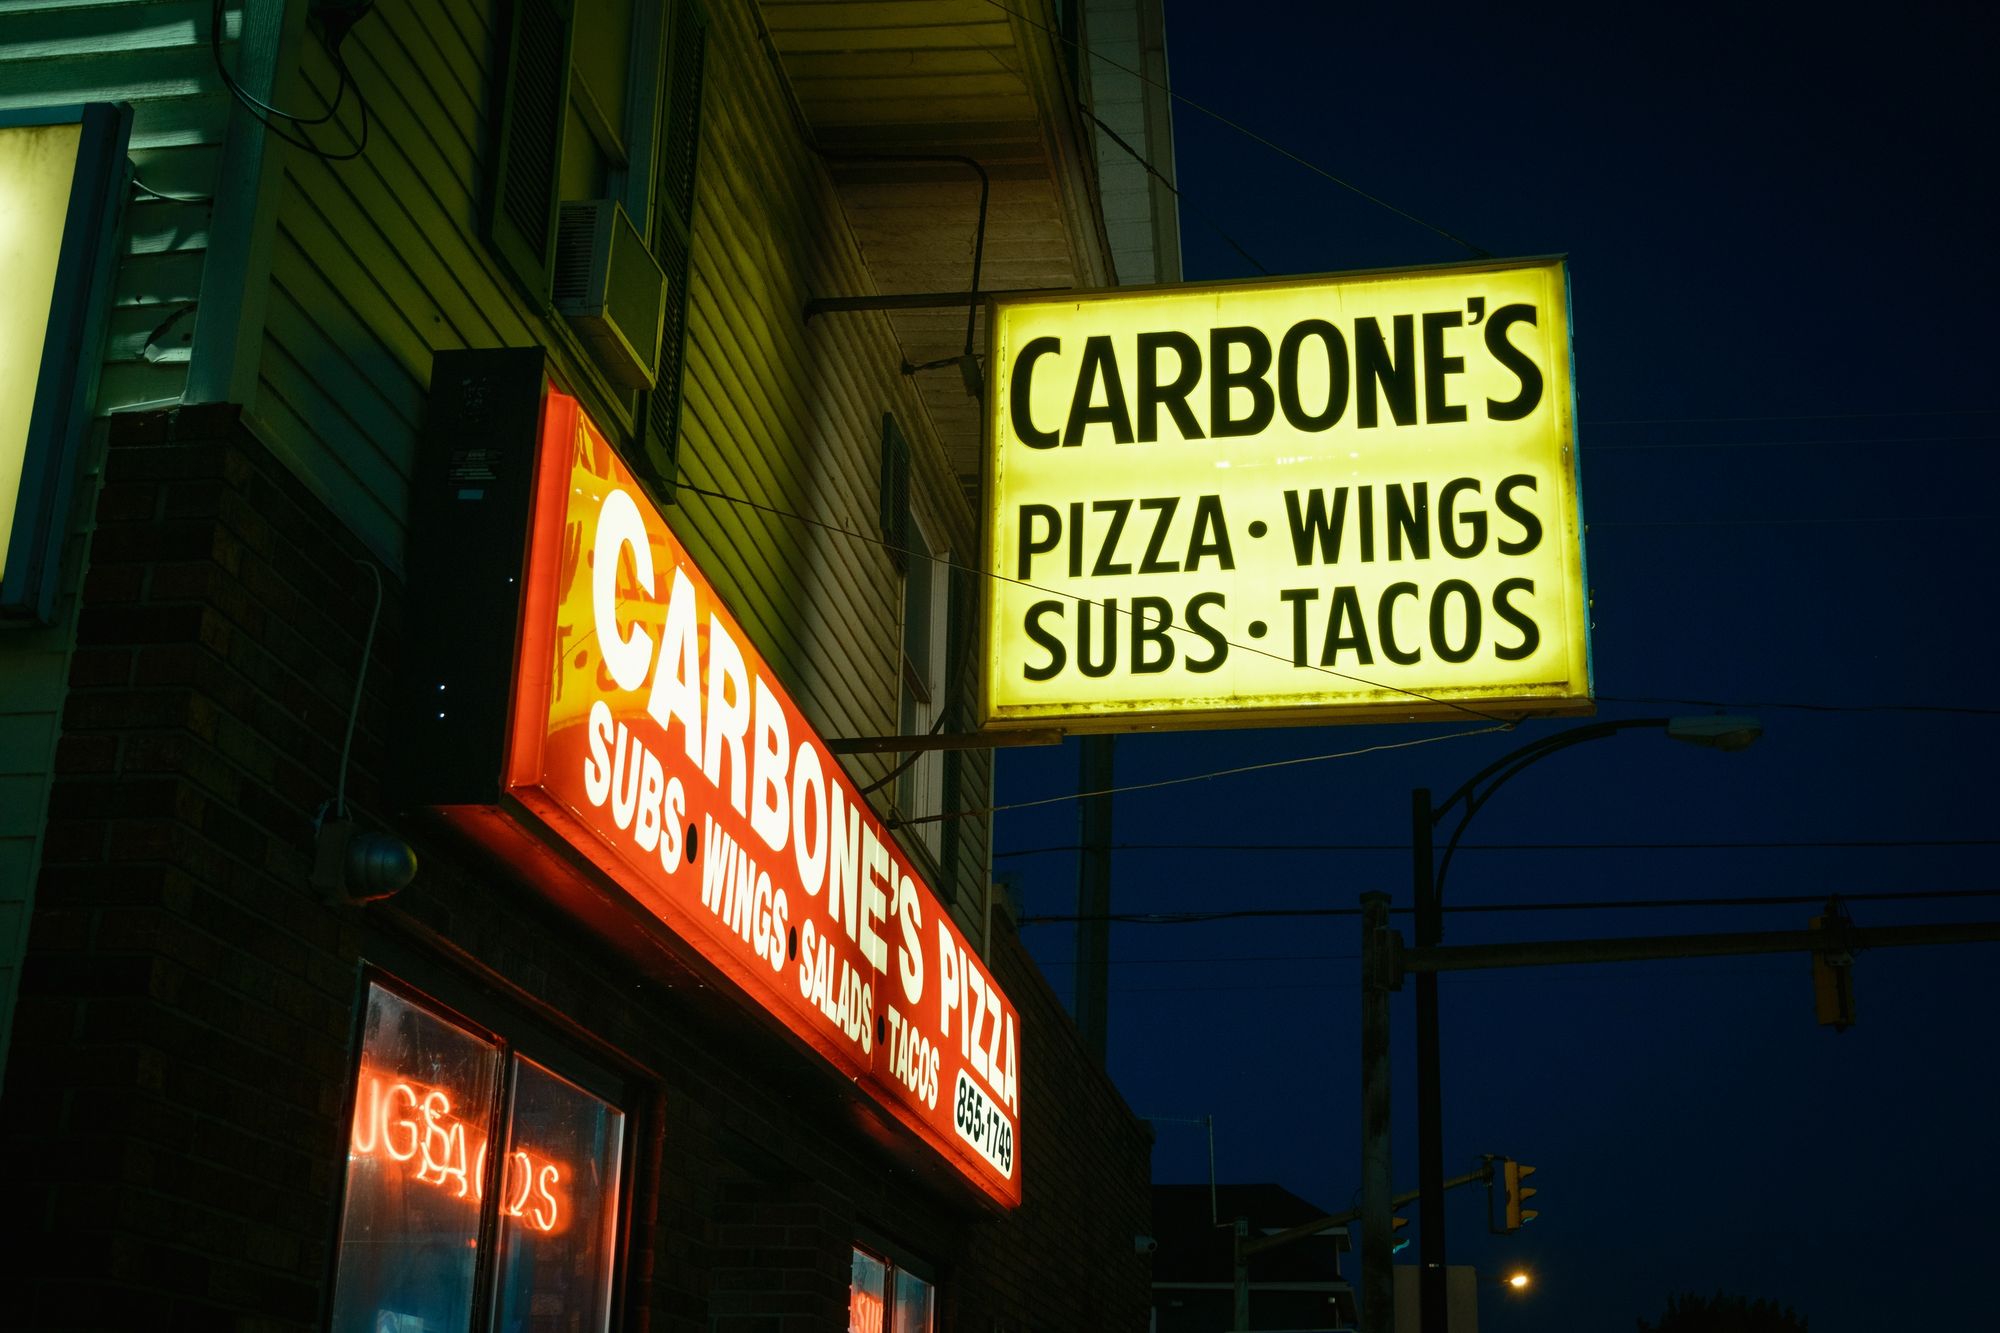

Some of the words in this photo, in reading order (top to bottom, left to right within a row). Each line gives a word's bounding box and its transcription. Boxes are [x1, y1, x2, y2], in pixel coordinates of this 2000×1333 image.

[1009, 297, 1545, 450] CARBONE'S
[1017, 494, 1236, 581] PIZZA
[1283, 474, 1543, 567] WINGS
[1023, 592, 1230, 681] SUBS
[1280, 577, 1541, 668] TACOS
[592, 489, 924, 1005] CARBONE'S
[938, 918, 1018, 1119] PIZZA
[584, 700, 686, 874] SUBS
[701, 811, 789, 973] WINGS
[799, 918, 873, 1056] SALADS
[887, 1004, 940, 1111] TACOS
[956, 1076, 1013, 1173] 855-1749
